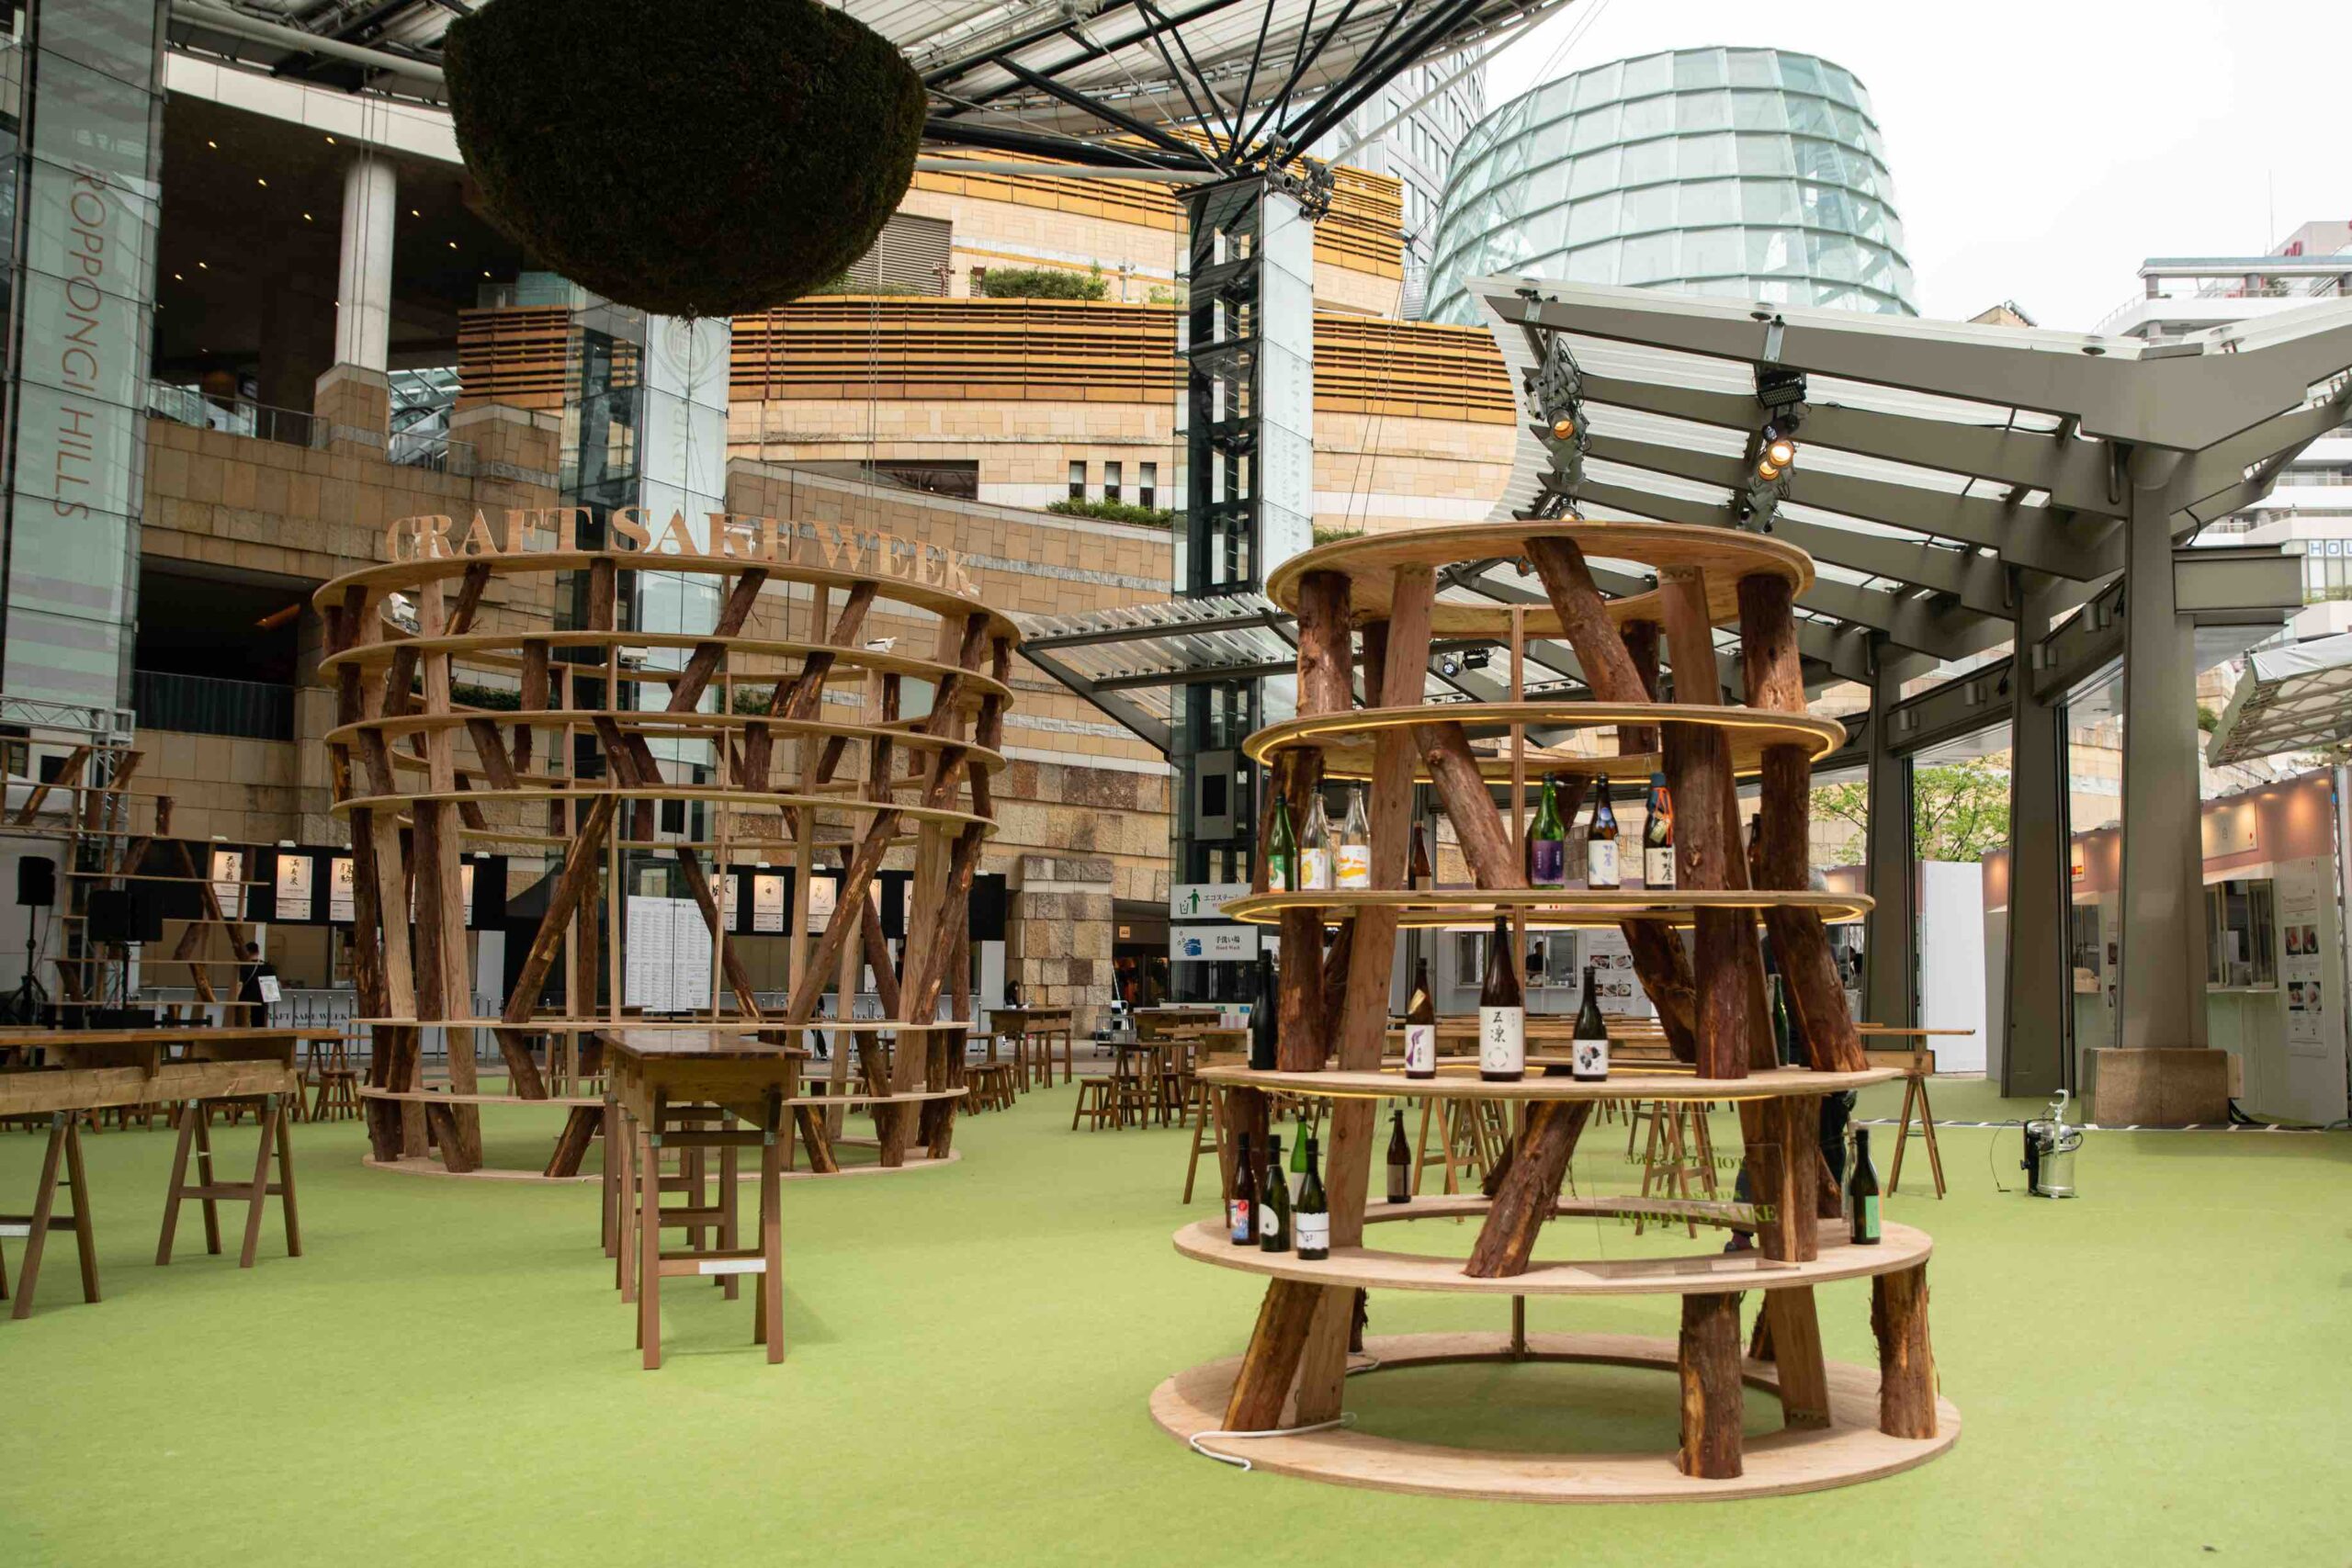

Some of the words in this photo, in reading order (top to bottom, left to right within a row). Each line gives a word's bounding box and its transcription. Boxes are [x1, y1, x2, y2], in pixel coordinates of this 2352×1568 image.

[62, 163, 107, 393] ROPPONGI
[53, 406, 94, 520] HILLS
[386, 506, 593, 561] CRAFT
[609, 506, 802, 564] SAKE
[808, 520, 971, 596] WEEK
